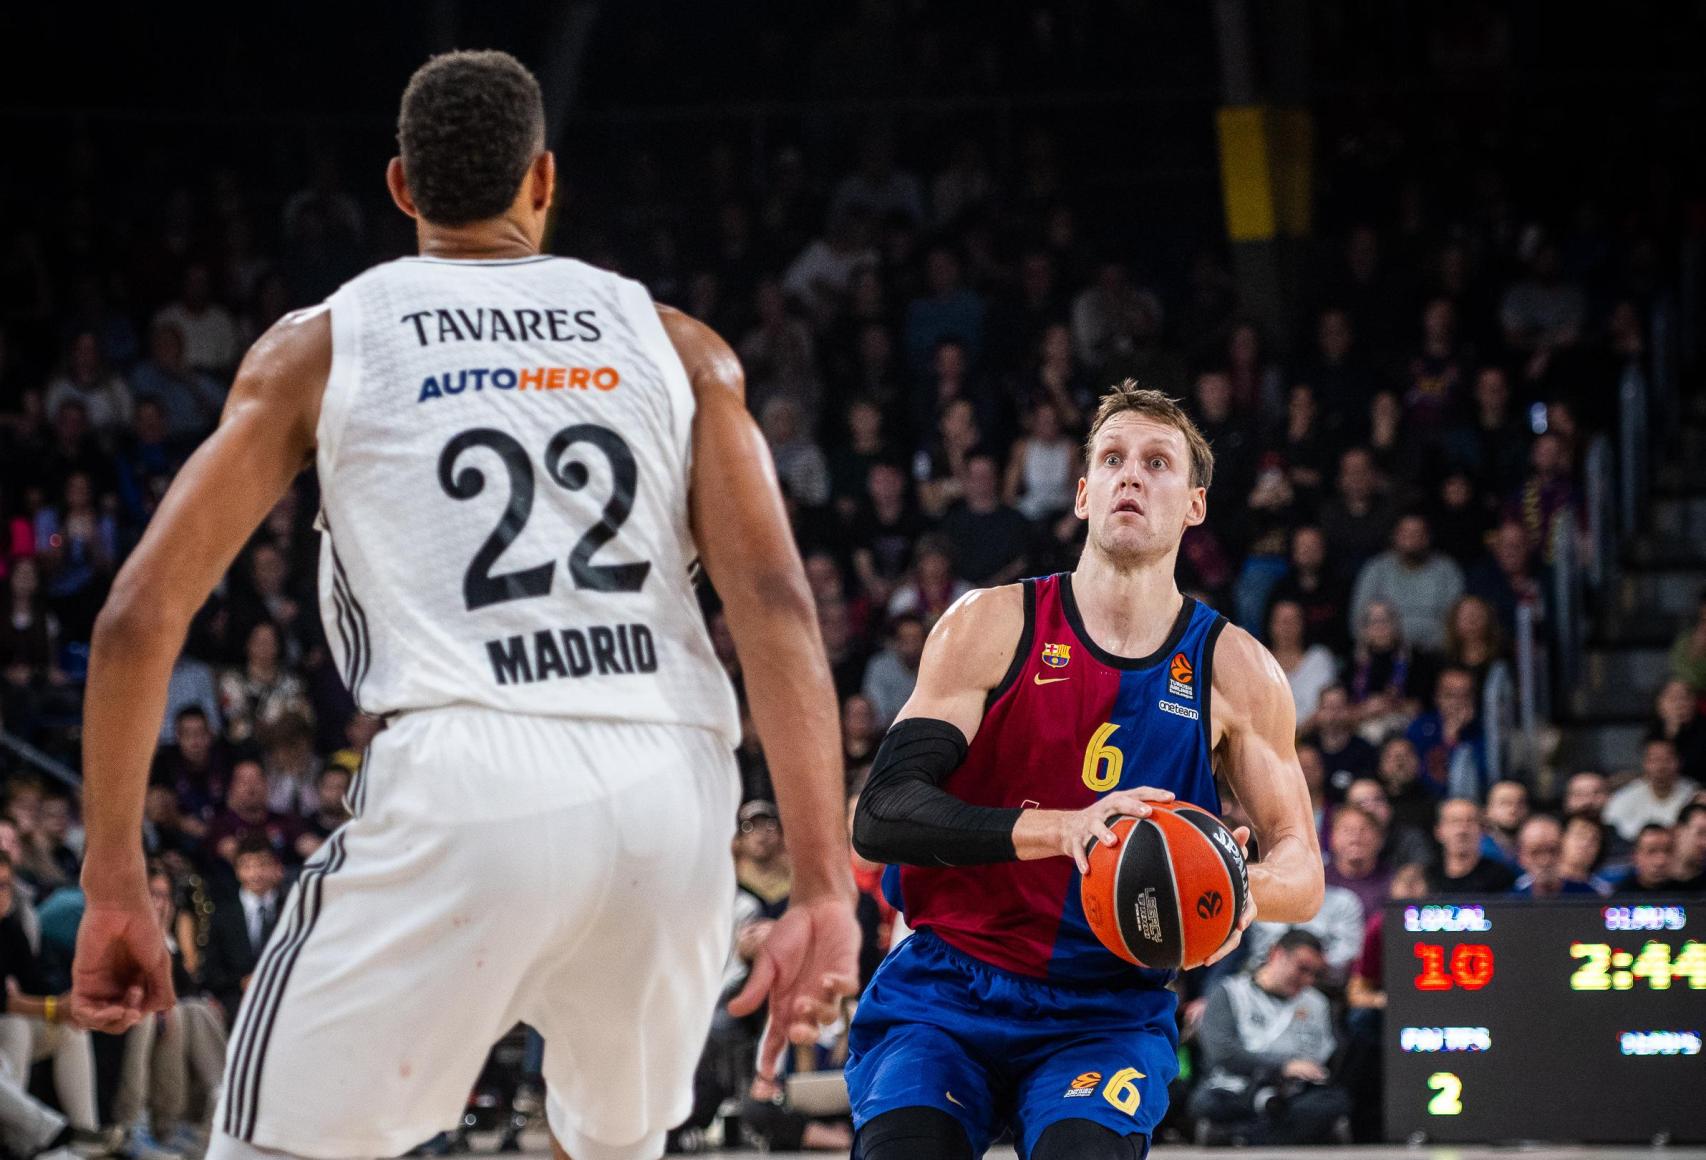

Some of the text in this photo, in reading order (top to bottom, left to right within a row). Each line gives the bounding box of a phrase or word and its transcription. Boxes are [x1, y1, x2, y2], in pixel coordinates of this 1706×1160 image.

[401, 309, 602, 346] TAVARES
[417, 367, 620, 403] AUTOHERO
[437, 423, 652, 611] 22
[485, 623, 658, 686] MADRID
[1159, 700, 1198, 720] oneteam
[1081, 722, 1123, 792] 6
[1413, 942, 1494, 990] 10
[1569, 940, 1706, 990] 2:44
[1102, 1067, 1147, 1117] 6
[1427, 1071, 1463, 1116] 2
